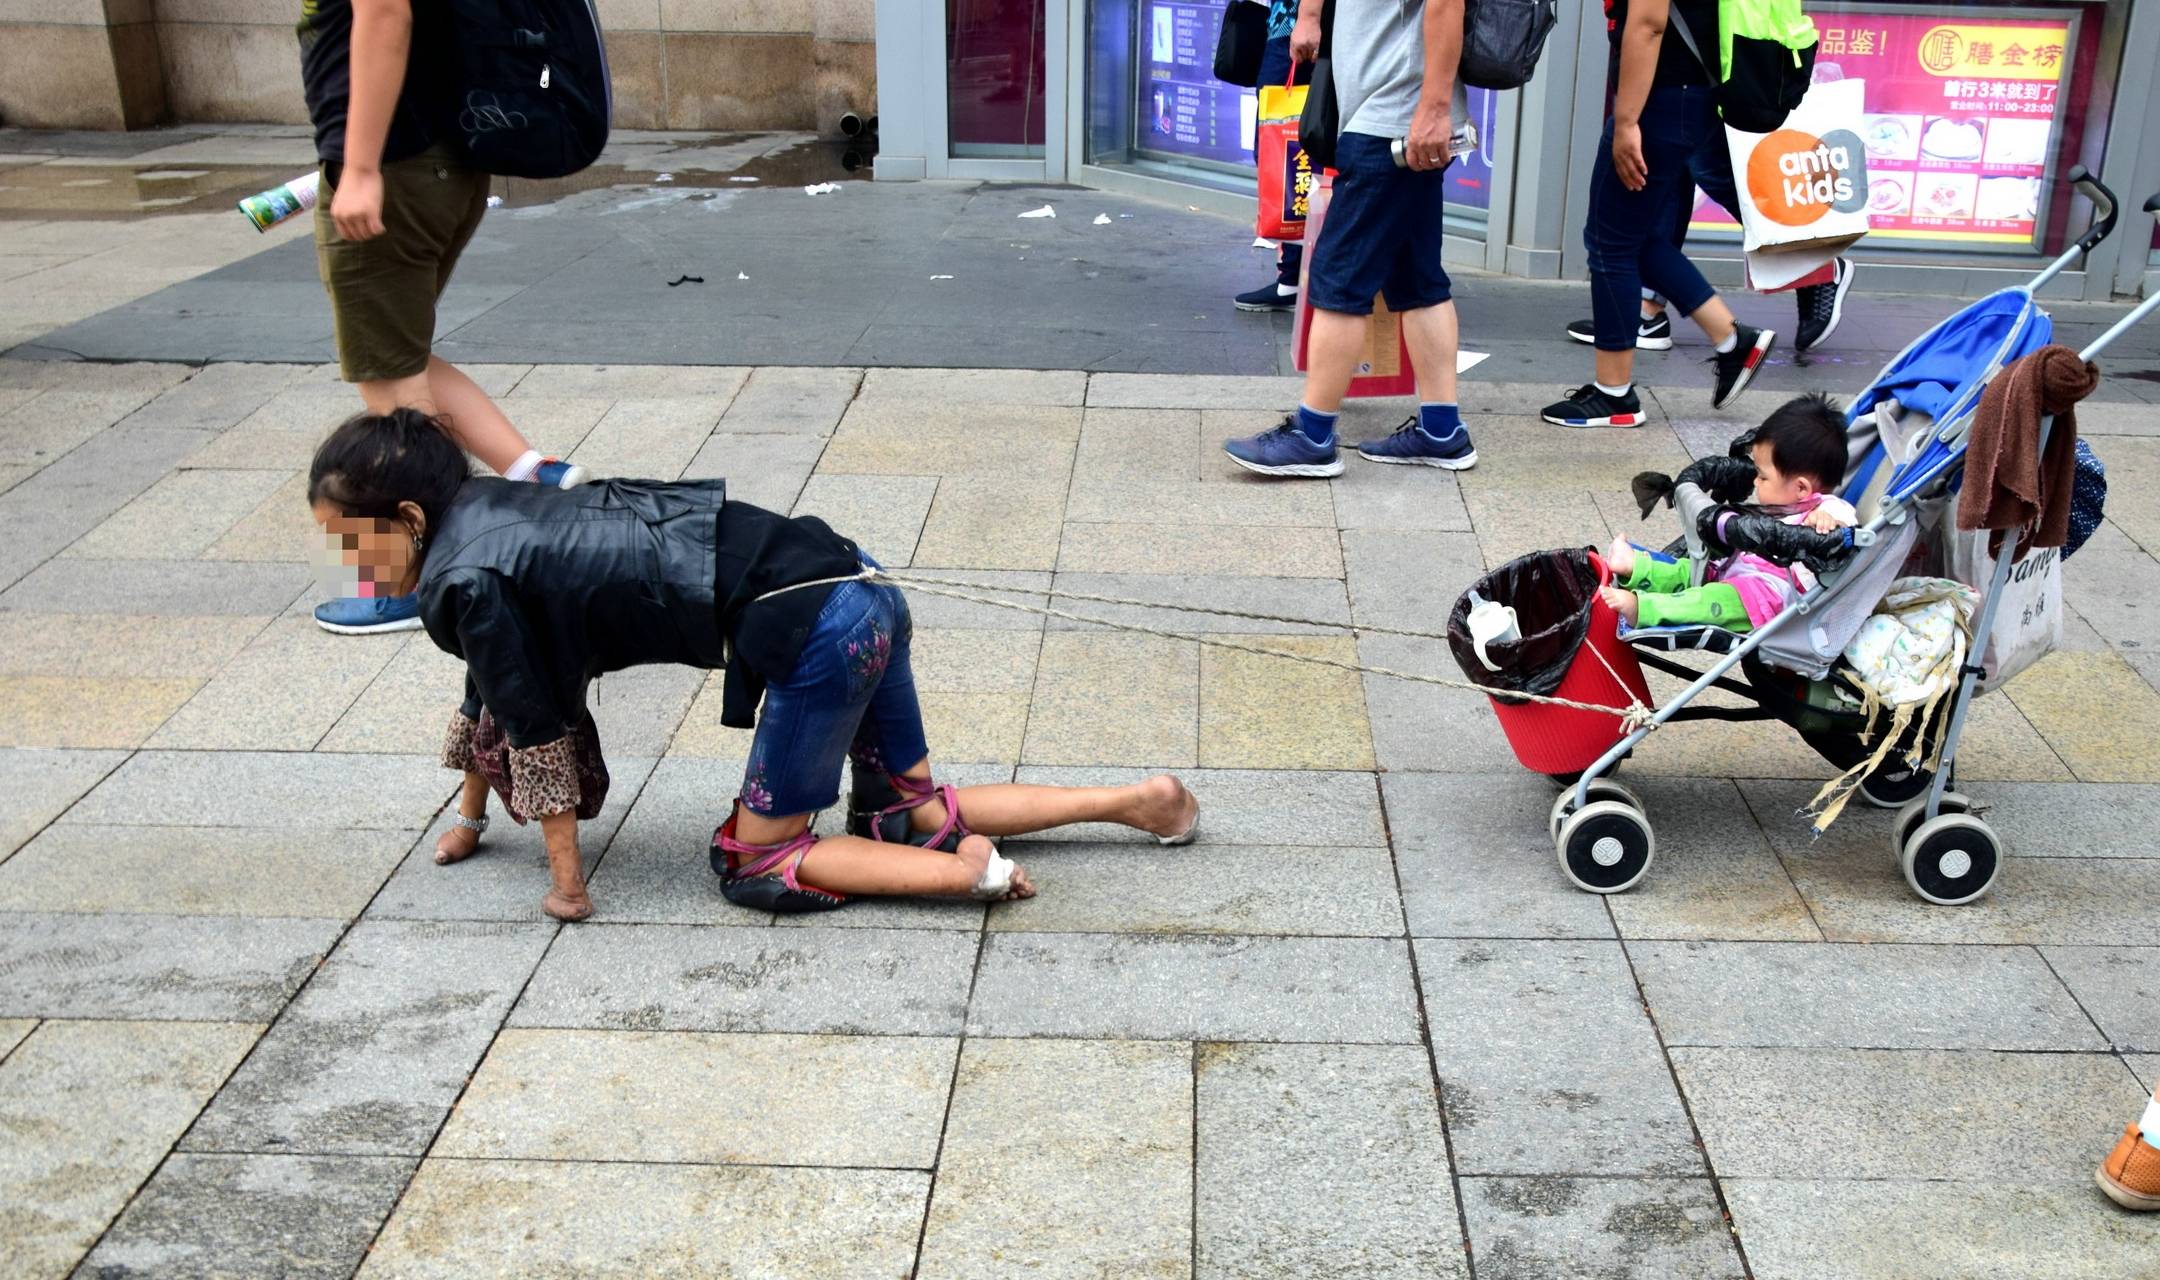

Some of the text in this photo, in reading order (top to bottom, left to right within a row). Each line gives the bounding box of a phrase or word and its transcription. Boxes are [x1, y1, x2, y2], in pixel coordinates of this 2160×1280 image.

[1816, 28, 1887, 56] 品鉴!
[1778, 143, 1849, 177] anta
[1782, 172, 1853, 208] kids
